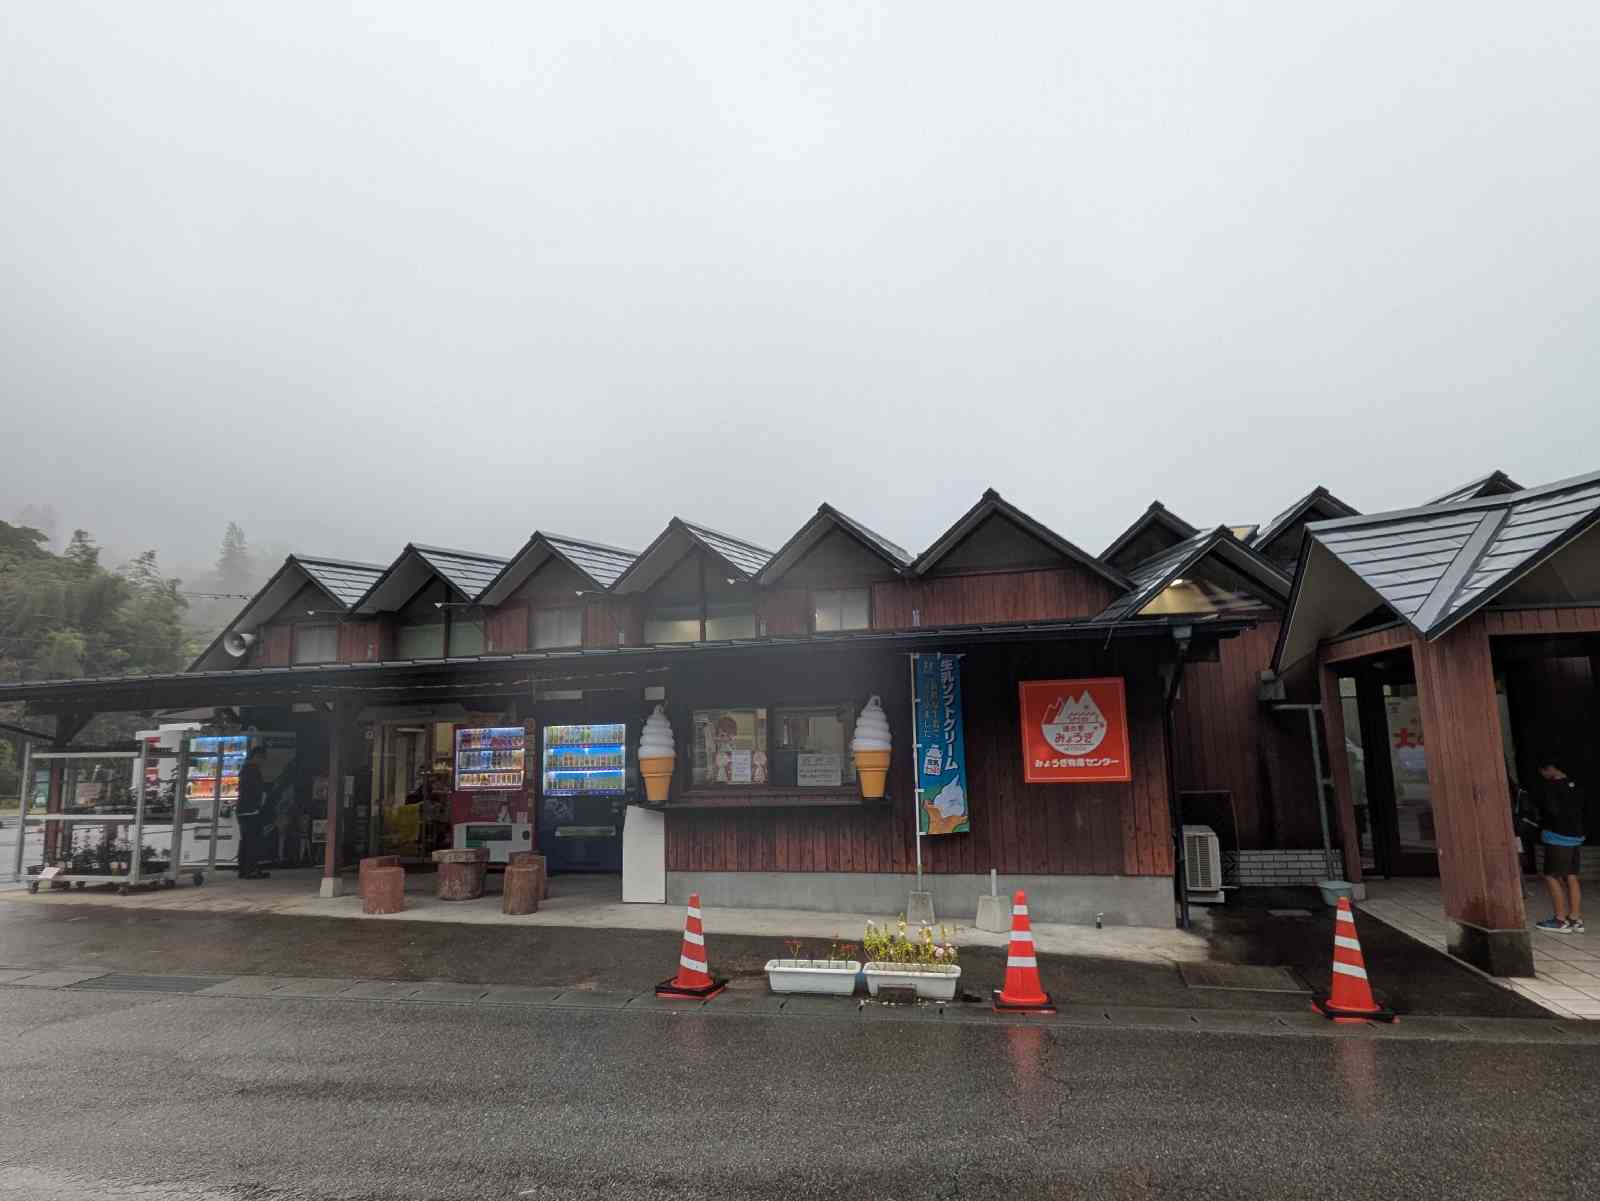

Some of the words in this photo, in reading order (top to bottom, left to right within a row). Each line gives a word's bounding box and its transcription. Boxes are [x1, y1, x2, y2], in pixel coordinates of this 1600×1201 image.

[940, 658, 959, 770] 生乳ソフトクリーム
